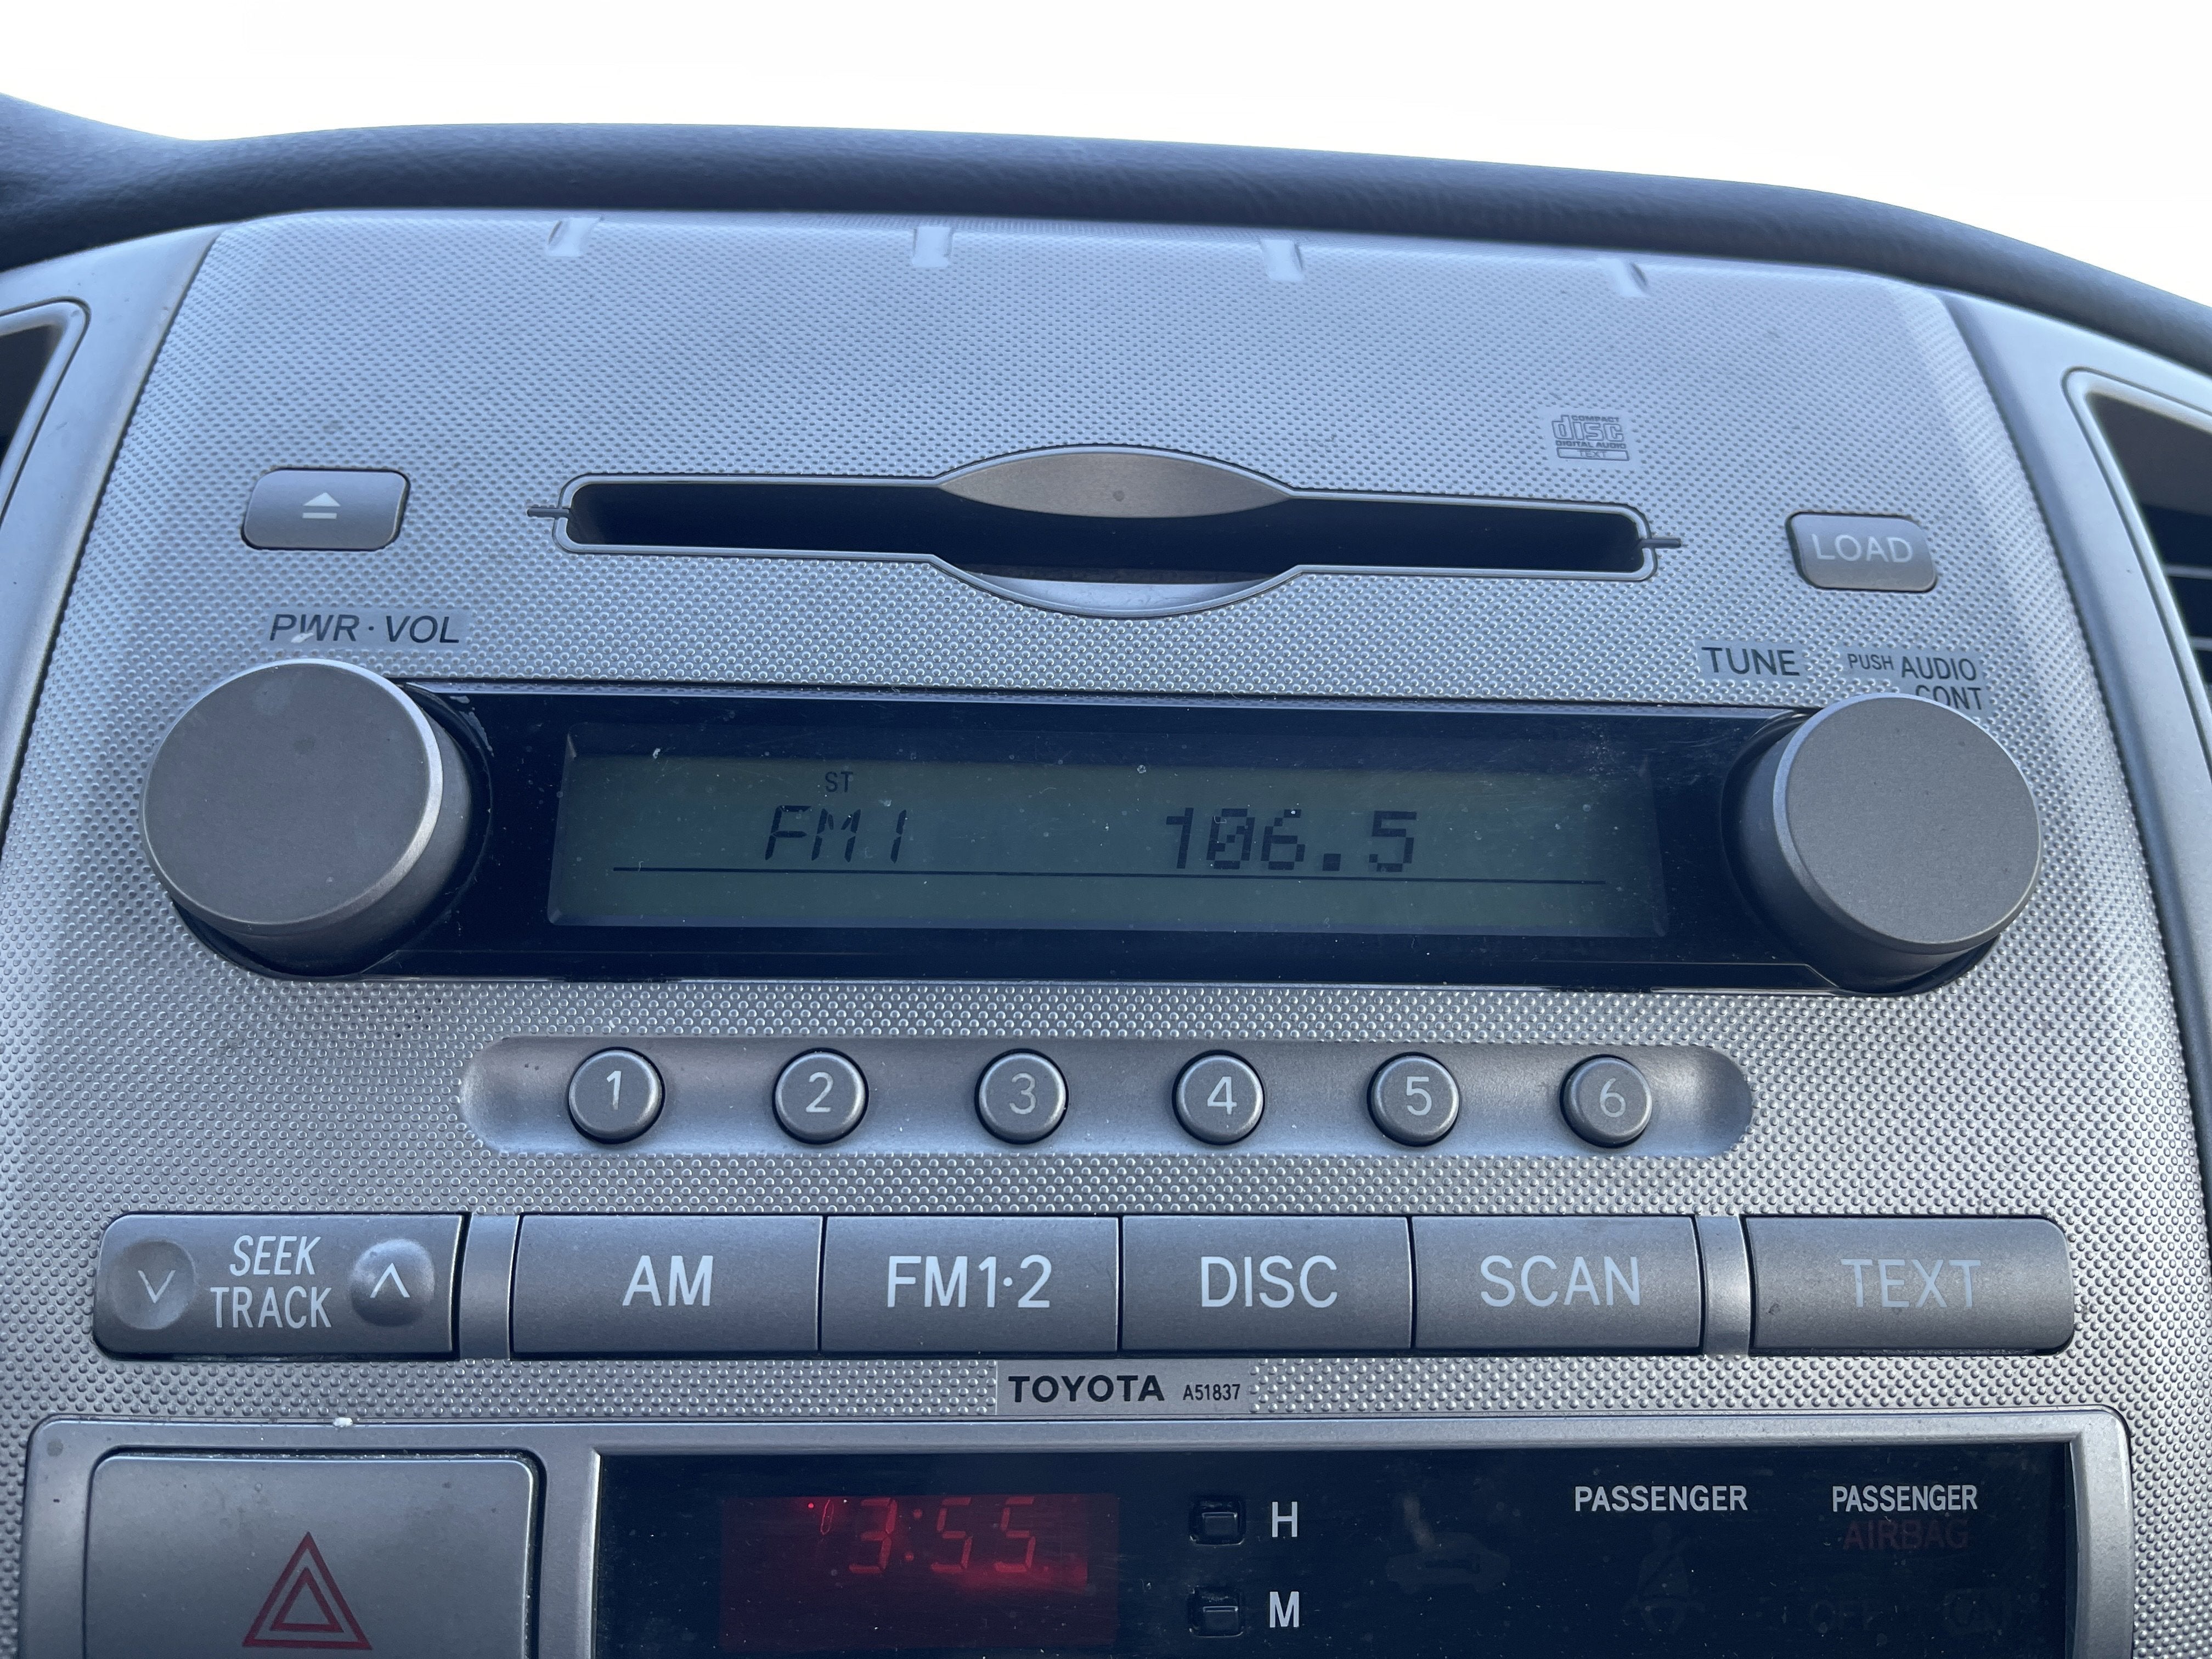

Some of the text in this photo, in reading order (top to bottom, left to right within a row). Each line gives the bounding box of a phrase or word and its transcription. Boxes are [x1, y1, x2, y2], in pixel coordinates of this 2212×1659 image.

[1556, 440, 1593, 448] DIGITAL
[1577, 450, 1607, 458] TEXT
[1812, 534, 1913, 563] LOAD
[1702, 646, 1800, 677] TUNE
[1847, 653, 1976, 681] PUSH AUDIO
[825, 771, 854, 793] ST
[765, 805, 907, 864] FM1
[1166, 807, 1417, 872] 106.5
[606, 1070, 623, 1110] 1
[805, 1071, 834, 1113] 2
[1009, 1073, 1037, 1115] 3
[1207, 1076, 1237, 1115] 4
[1406, 1076, 1432, 1116] 5
[1599, 1078, 1627, 1118] 6
[230, 1235, 321, 1277] SEEK
[622, 1255, 713, 1307] AM
[1200, 1255, 1338, 1308] DISC
[1480, 1255, 1640, 1307] SCAN
[1841, 1259, 1981, 1308] TEXT
[211, 1286, 332, 1329] TRACK
[1008, 1375, 1240, 1403] TOYOTA A51837
[1575, 1485, 1748, 1511] PASSENGER
[1832, 1485, 1977, 1512] PASSENGER
[1271, 1502, 1298, 1537] H
[1842, 1519, 1970, 1551] AIRBAG
[1269, 1591, 1300, 1628] M
